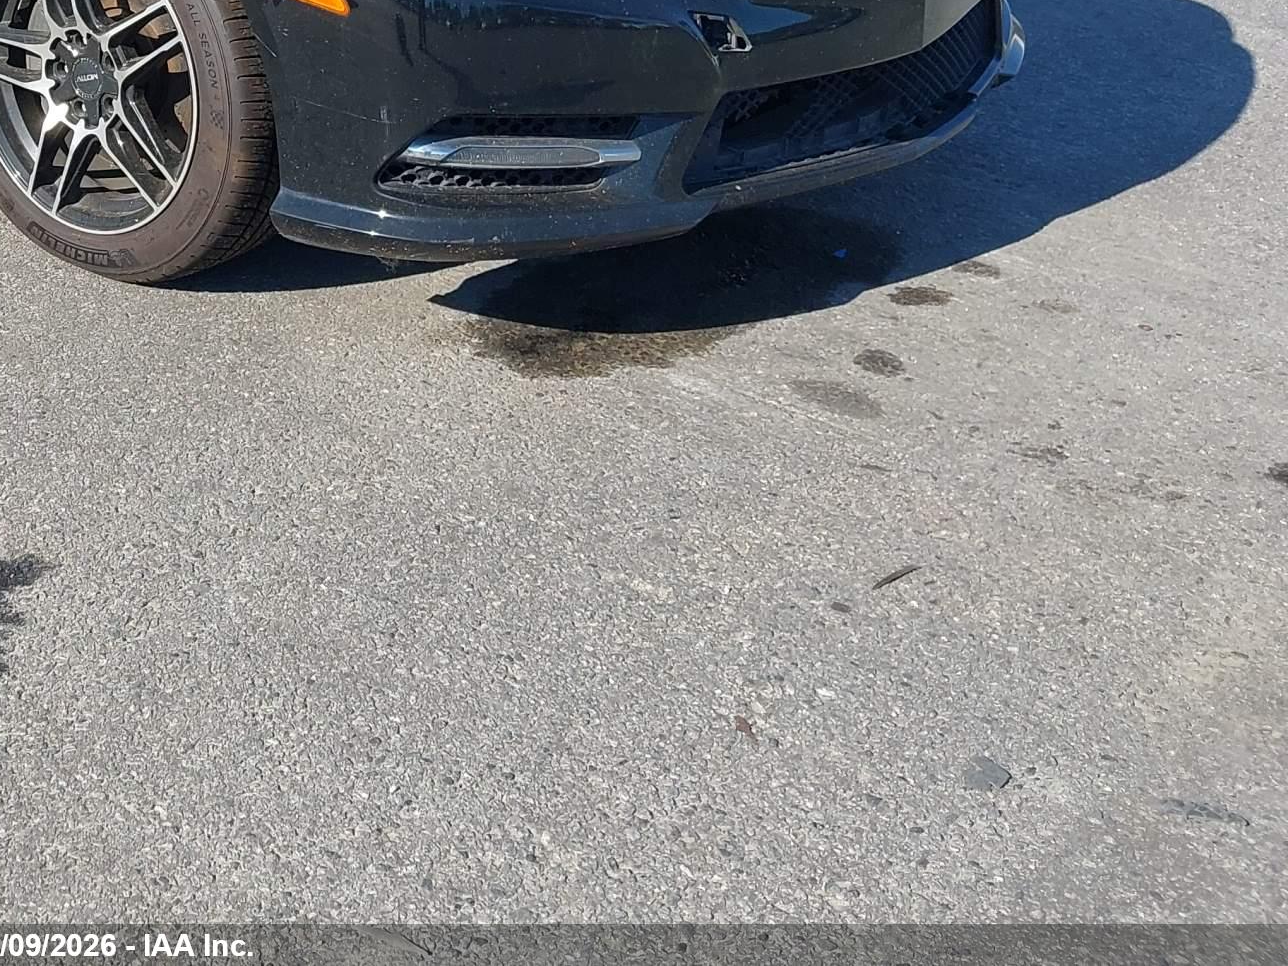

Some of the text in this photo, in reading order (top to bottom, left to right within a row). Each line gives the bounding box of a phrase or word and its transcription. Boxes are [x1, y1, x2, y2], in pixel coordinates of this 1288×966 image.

[186, 3, 201, 27] ALL
[198, 32, 218, 90] SEASON
[30, 225, 109, 267] MICHELIN
